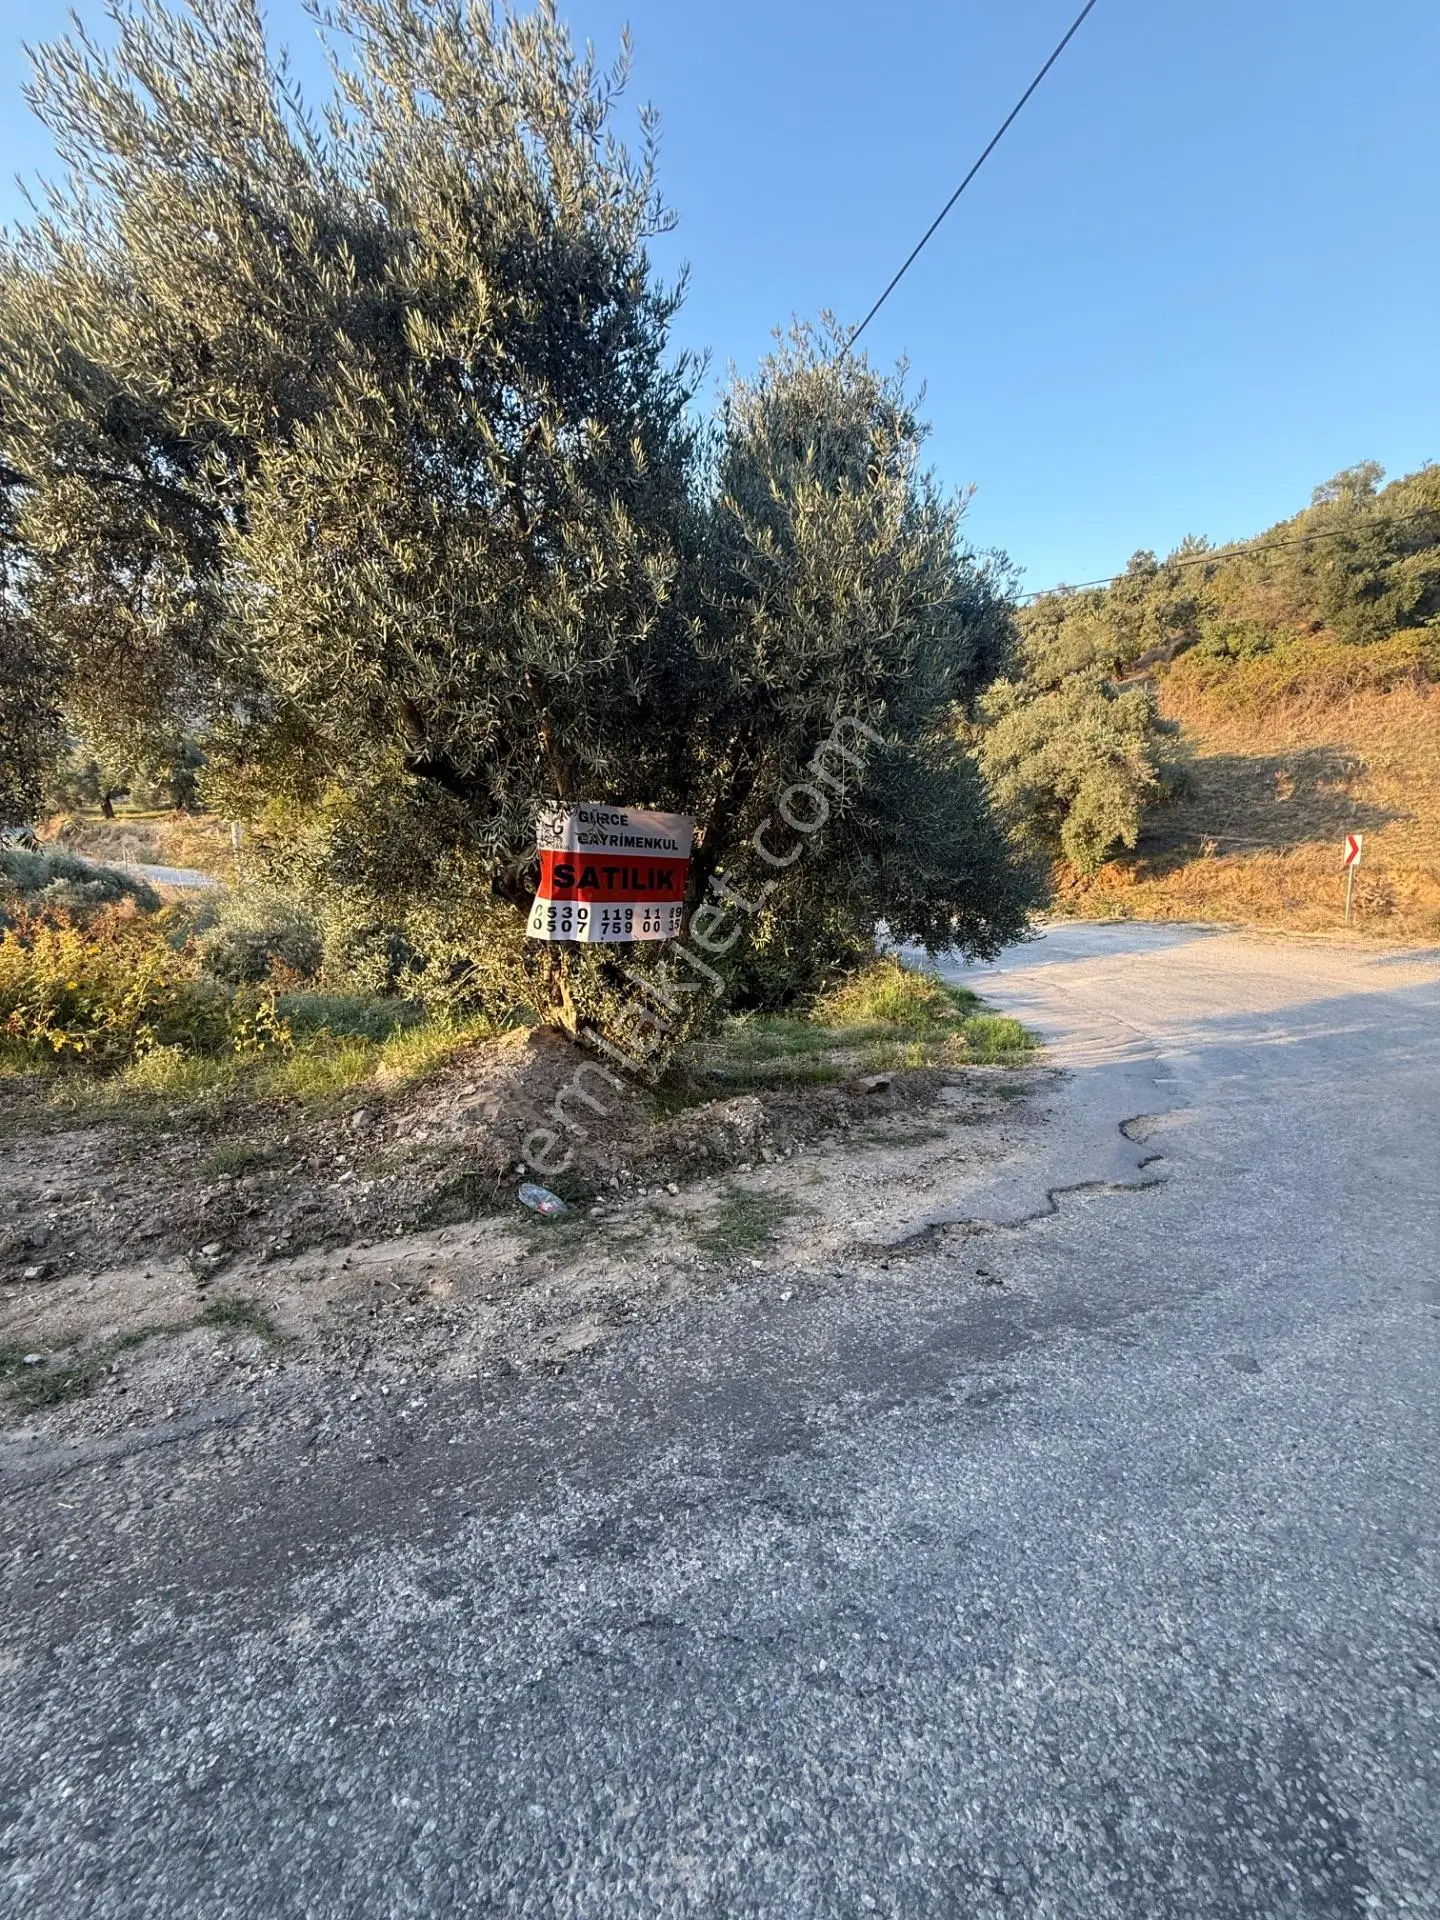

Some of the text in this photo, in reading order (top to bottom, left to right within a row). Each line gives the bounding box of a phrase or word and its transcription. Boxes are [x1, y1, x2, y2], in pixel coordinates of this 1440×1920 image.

[578, 809, 629, 826] GÜRCE
[578, 832, 678, 850] GAYRİMENKUL
[553, 864, 674, 890] SATILIK
[602, 908, 633, 921] 119
[644, 908, 660, 920] 11
[533, 918, 680, 934] 0507 759 00 35
